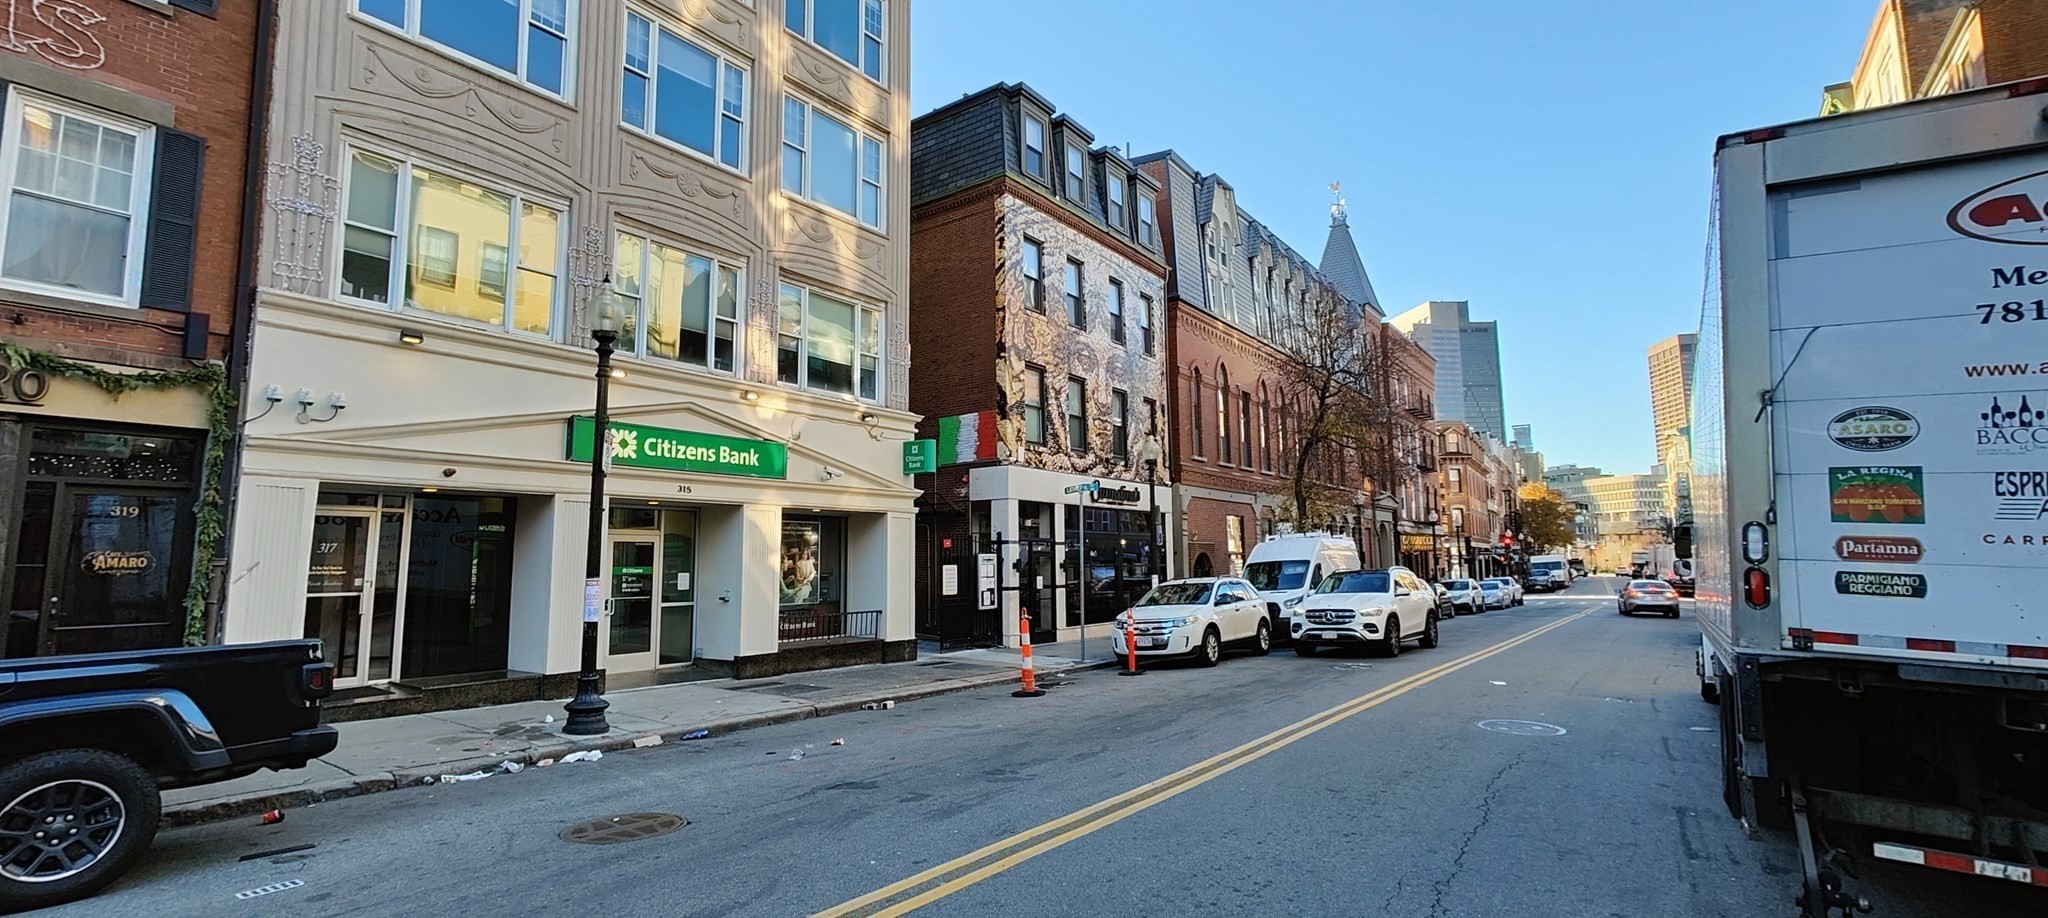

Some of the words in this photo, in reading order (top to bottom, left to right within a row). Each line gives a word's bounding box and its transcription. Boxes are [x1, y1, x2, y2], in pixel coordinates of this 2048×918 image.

[1968, 193, 2048, 227] A
[1976, 299, 2048, 324] 781
[1839, 422, 1908, 435] ASARO
[644, 438, 716, 462] Citizens
[719, 446, 759, 466] Bank
[1836, 470, 1857, 480] LA
[1860, 467, 1914, 480] REGINA
[677, 485, 692, 493] 315
[1995, 471, 2048, 496] ESPR
[110, 506, 139, 518] 319
[316, 542, 338, 553] 317
[92, 554, 147, 570] AMARO
[1841, 573, 1920, 586] PARMIGIANO
[1849, 584, 1913, 595] REGGIANO
